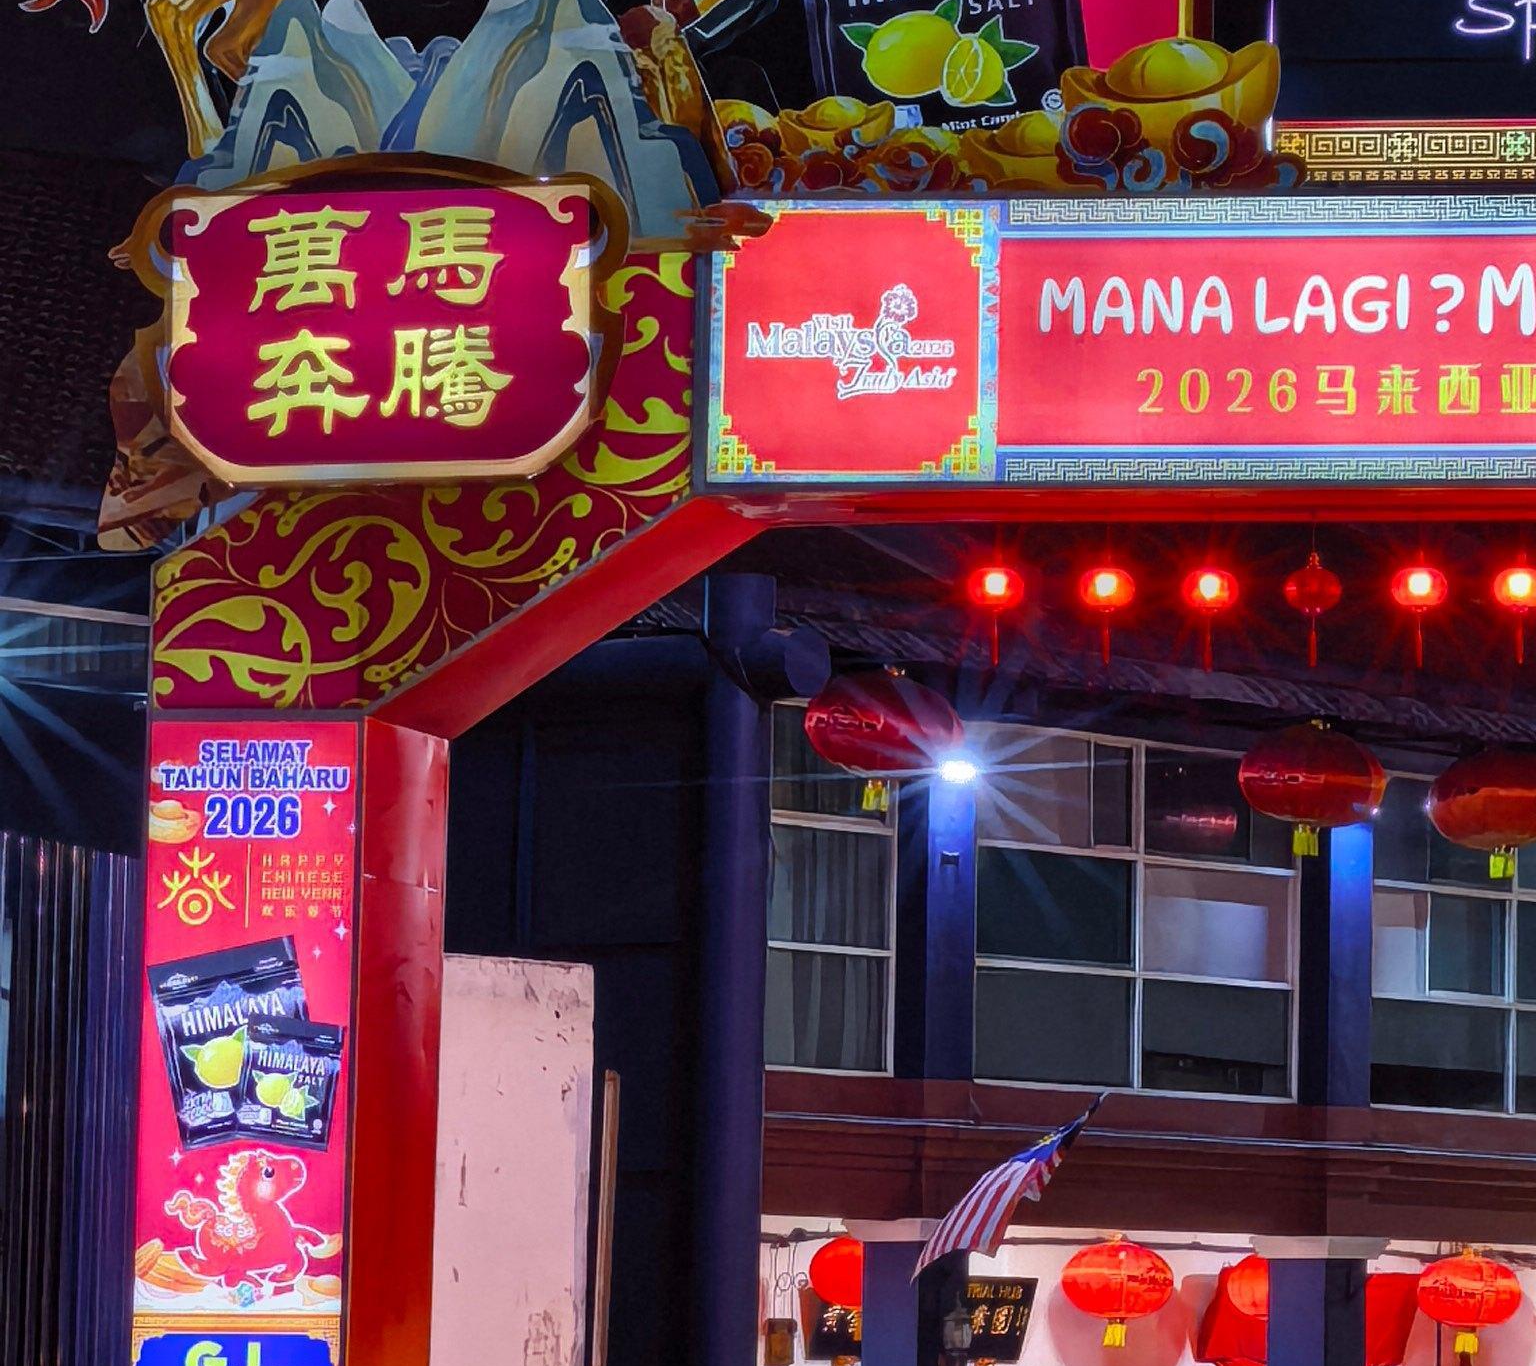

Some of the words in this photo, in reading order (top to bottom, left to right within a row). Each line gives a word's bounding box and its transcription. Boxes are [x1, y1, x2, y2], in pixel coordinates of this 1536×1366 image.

[246, 204, 505, 313] 萬馬
[1039, 275, 1233, 335] MANA
[245, 324, 515, 438] 奔騰
[200, 740, 312, 764] SELAMAT
[160, 767, 243, 789] TAHUN
[250, 767, 349, 790] BAHARU
[205, 796, 300, 836] 2026
[261, 870, 344, 884] CHINESE
[180, 993, 287, 1037] HIMALAYA
[257, 1048, 326, 1077] HIMALAYA
[297, 1074, 325, 1087] SALT
